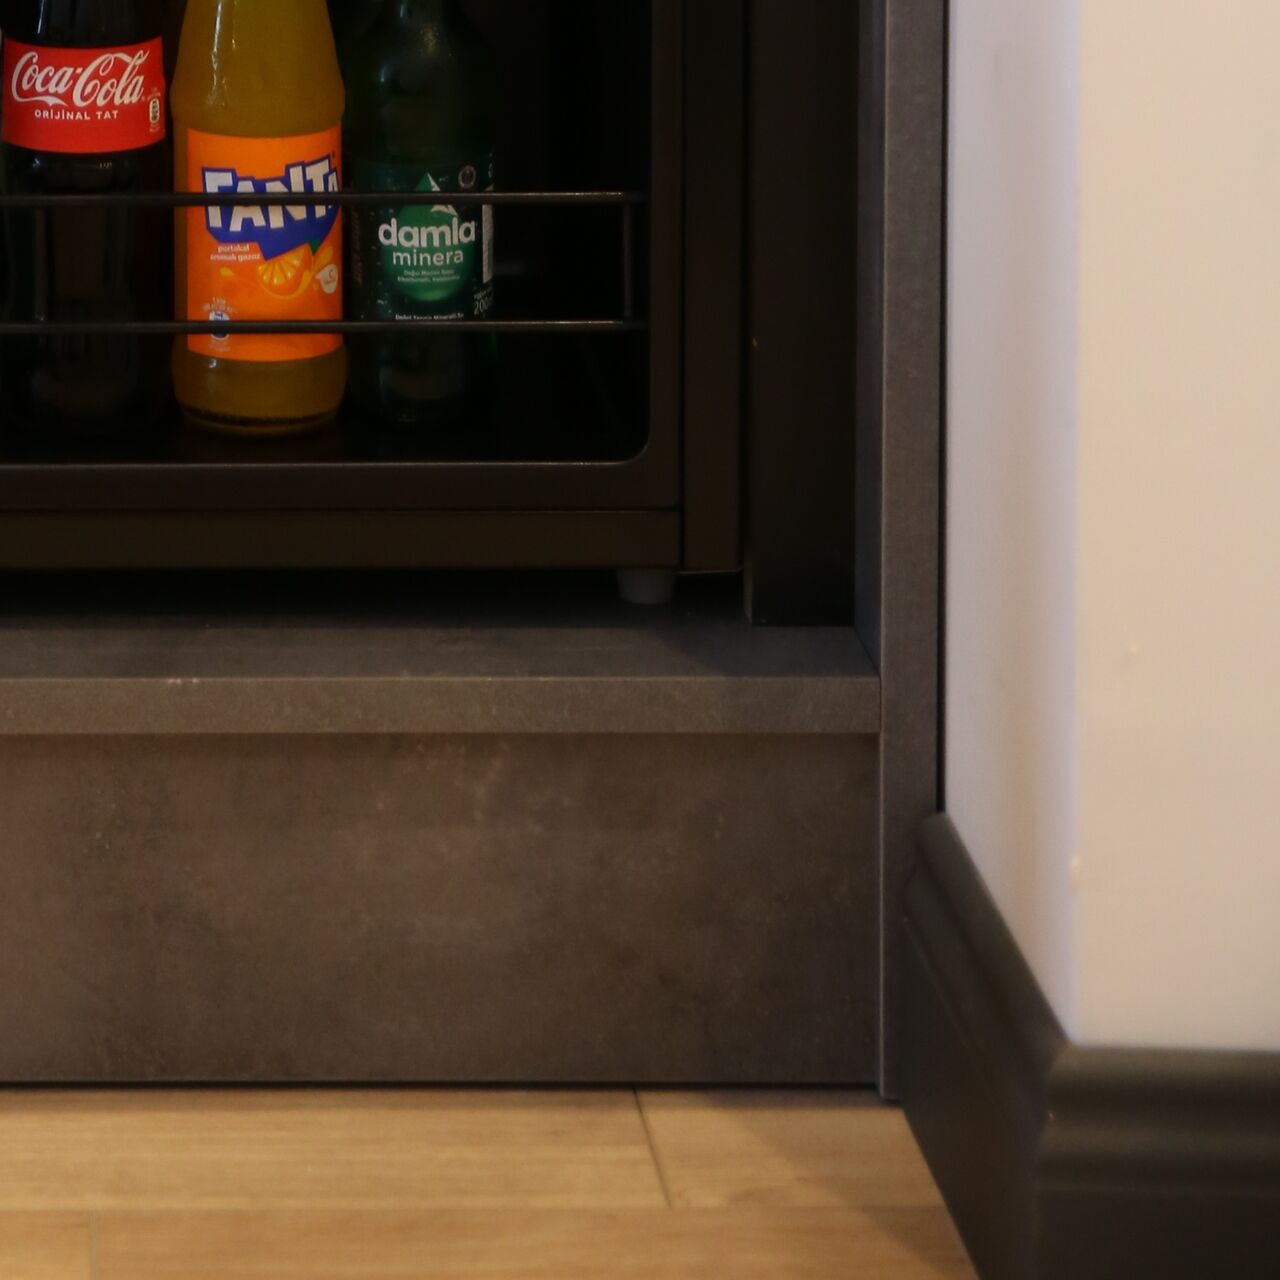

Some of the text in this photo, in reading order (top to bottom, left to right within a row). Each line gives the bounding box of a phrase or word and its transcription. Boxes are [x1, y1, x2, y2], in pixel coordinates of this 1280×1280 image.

[11, 48, 150, 108] Coca-Cola
[34, 108, 119, 121] ORİJİNAL TAT
[204, 157, 339, 233] FANTA
[377, 216, 477, 248] damla
[392, 249, 464, 267] minera
